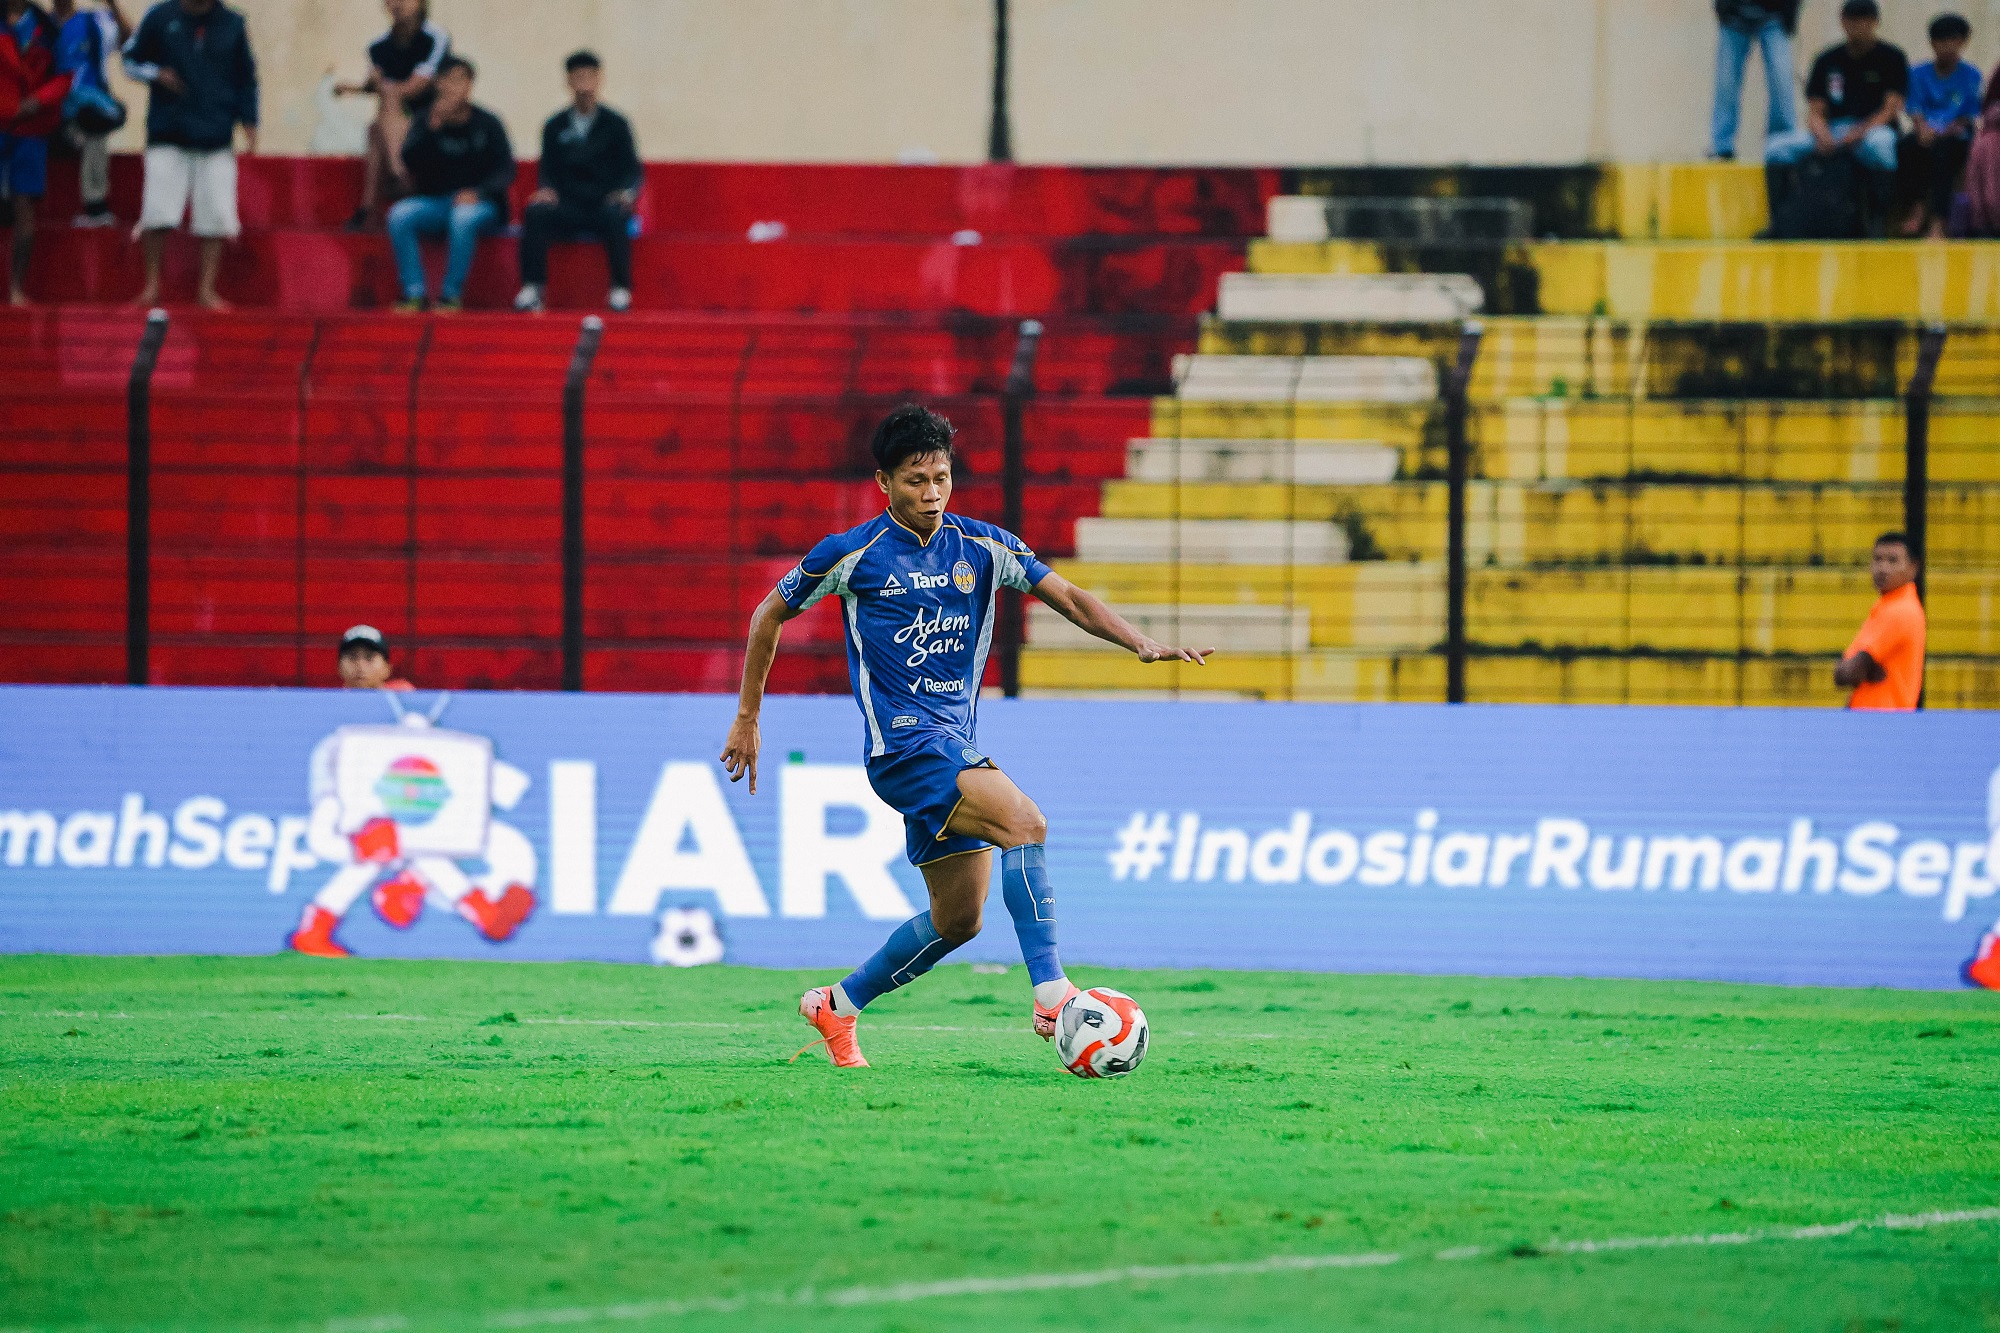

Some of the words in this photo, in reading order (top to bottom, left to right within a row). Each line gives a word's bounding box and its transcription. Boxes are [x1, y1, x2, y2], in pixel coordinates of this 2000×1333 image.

[908, 572, 948, 589] Taro
[880, 588, 907, 597] apex
[894, 606, 969, 643] Adem
